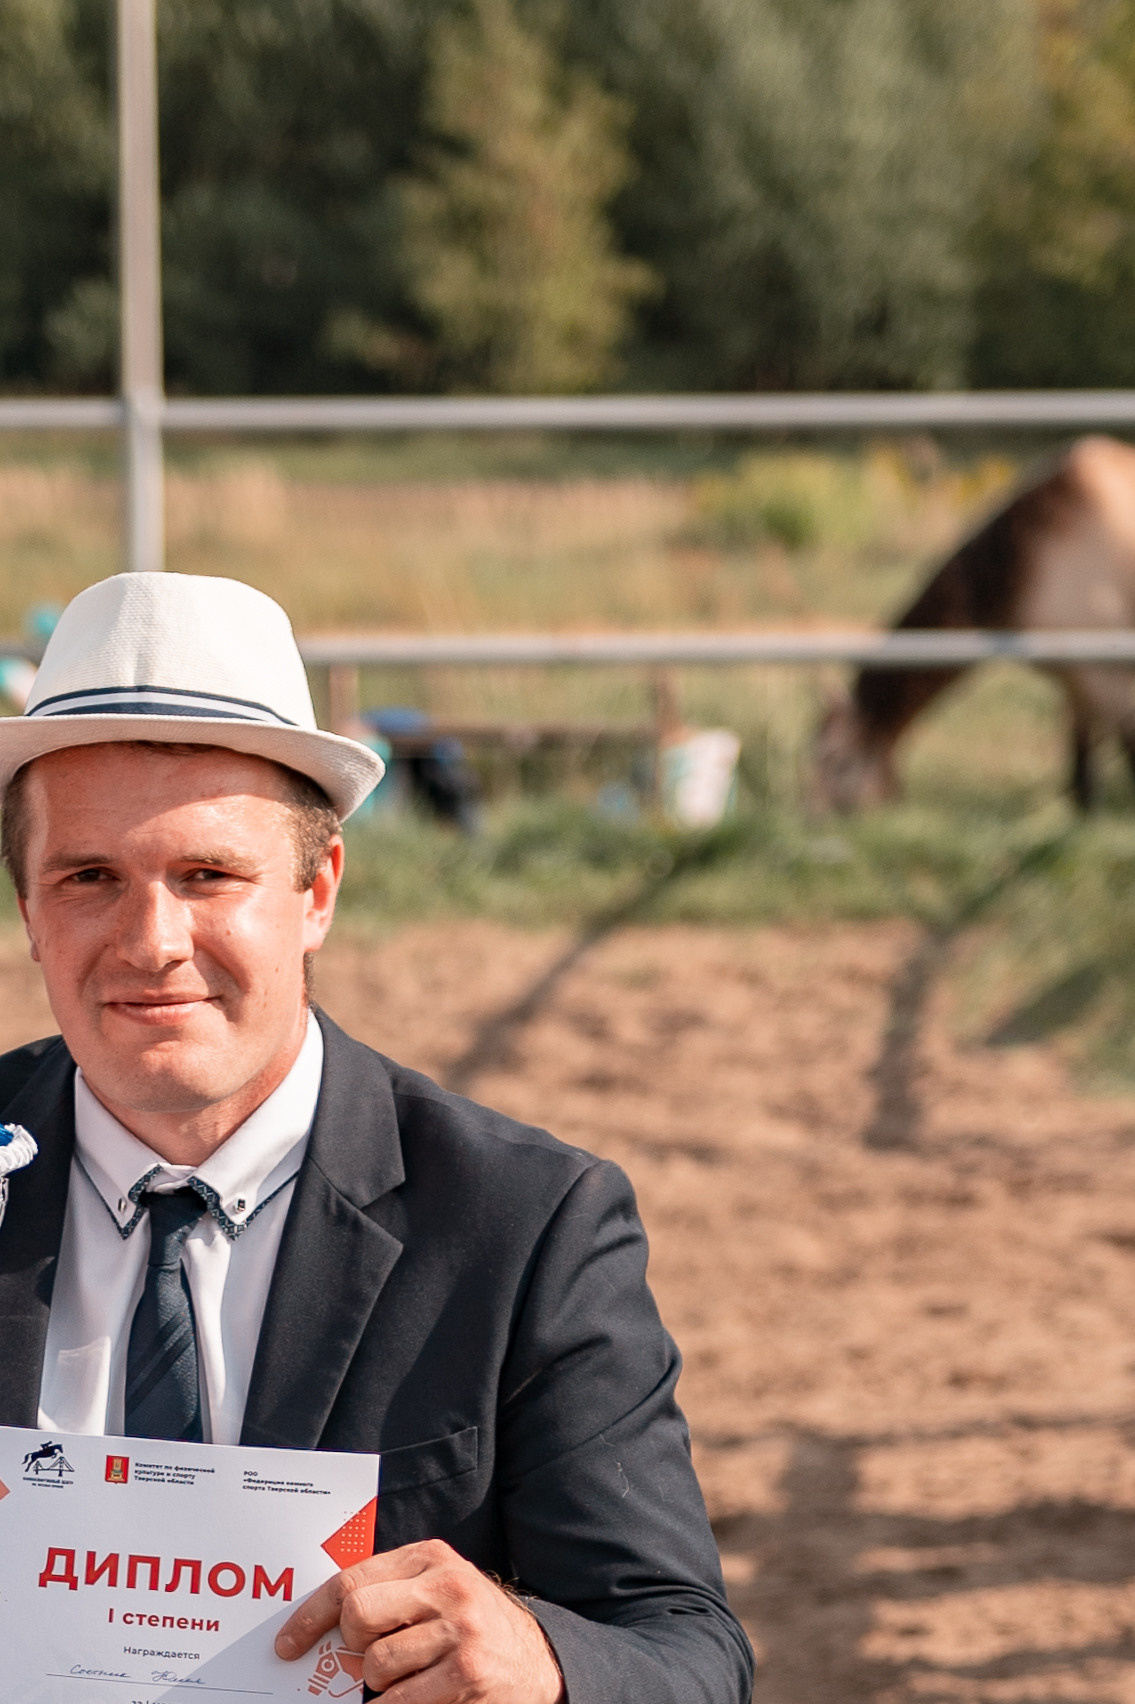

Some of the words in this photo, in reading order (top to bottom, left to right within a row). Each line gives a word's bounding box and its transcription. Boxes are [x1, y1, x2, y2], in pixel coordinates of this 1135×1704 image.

[38, 1546, 295, 1602] ДИПЛОМ
[107, 1607, 114, 1624] I
[122, 1611, 221, 1633] степени
[123, 1646, 200, 1661] Награждается
